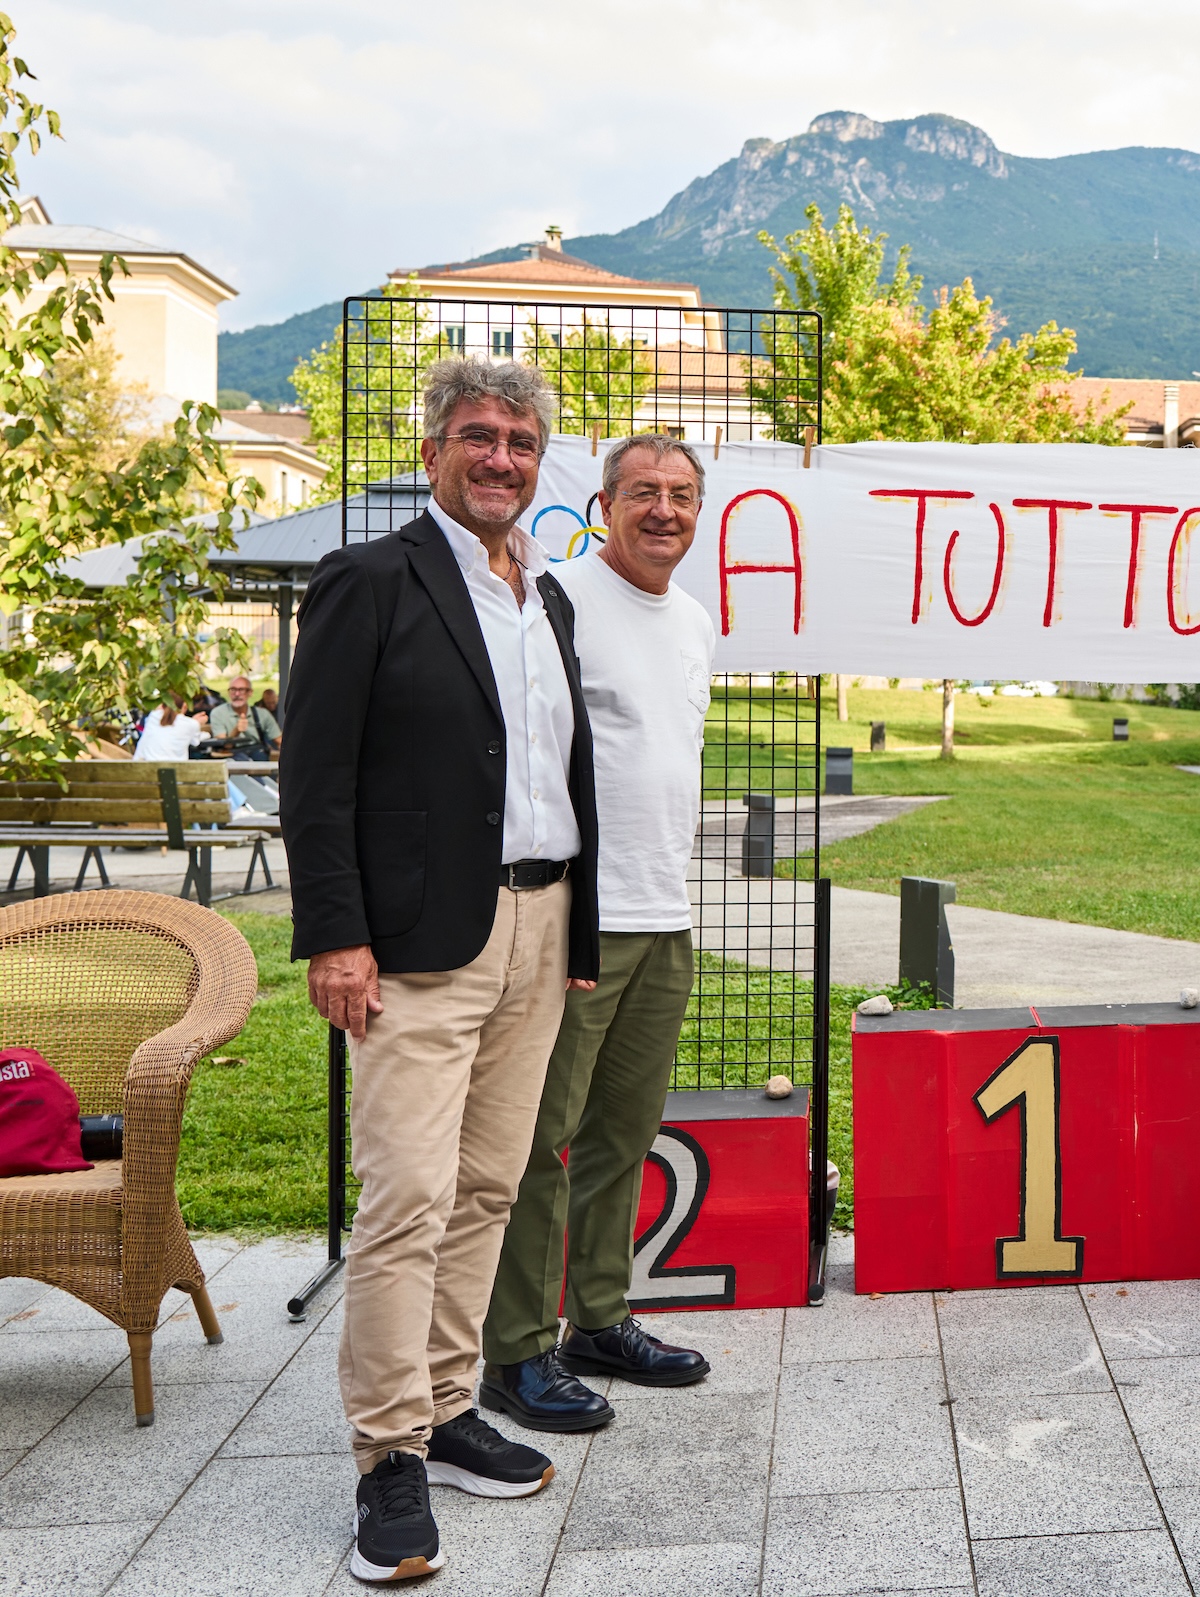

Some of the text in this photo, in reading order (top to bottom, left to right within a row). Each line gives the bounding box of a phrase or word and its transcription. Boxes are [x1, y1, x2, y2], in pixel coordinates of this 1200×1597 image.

[719, 488, 802, 637] A
[0, 1060, 36, 1083] sta!
[626, 1124, 737, 1309] 2
[971, 1034, 1087, 1280] 1
